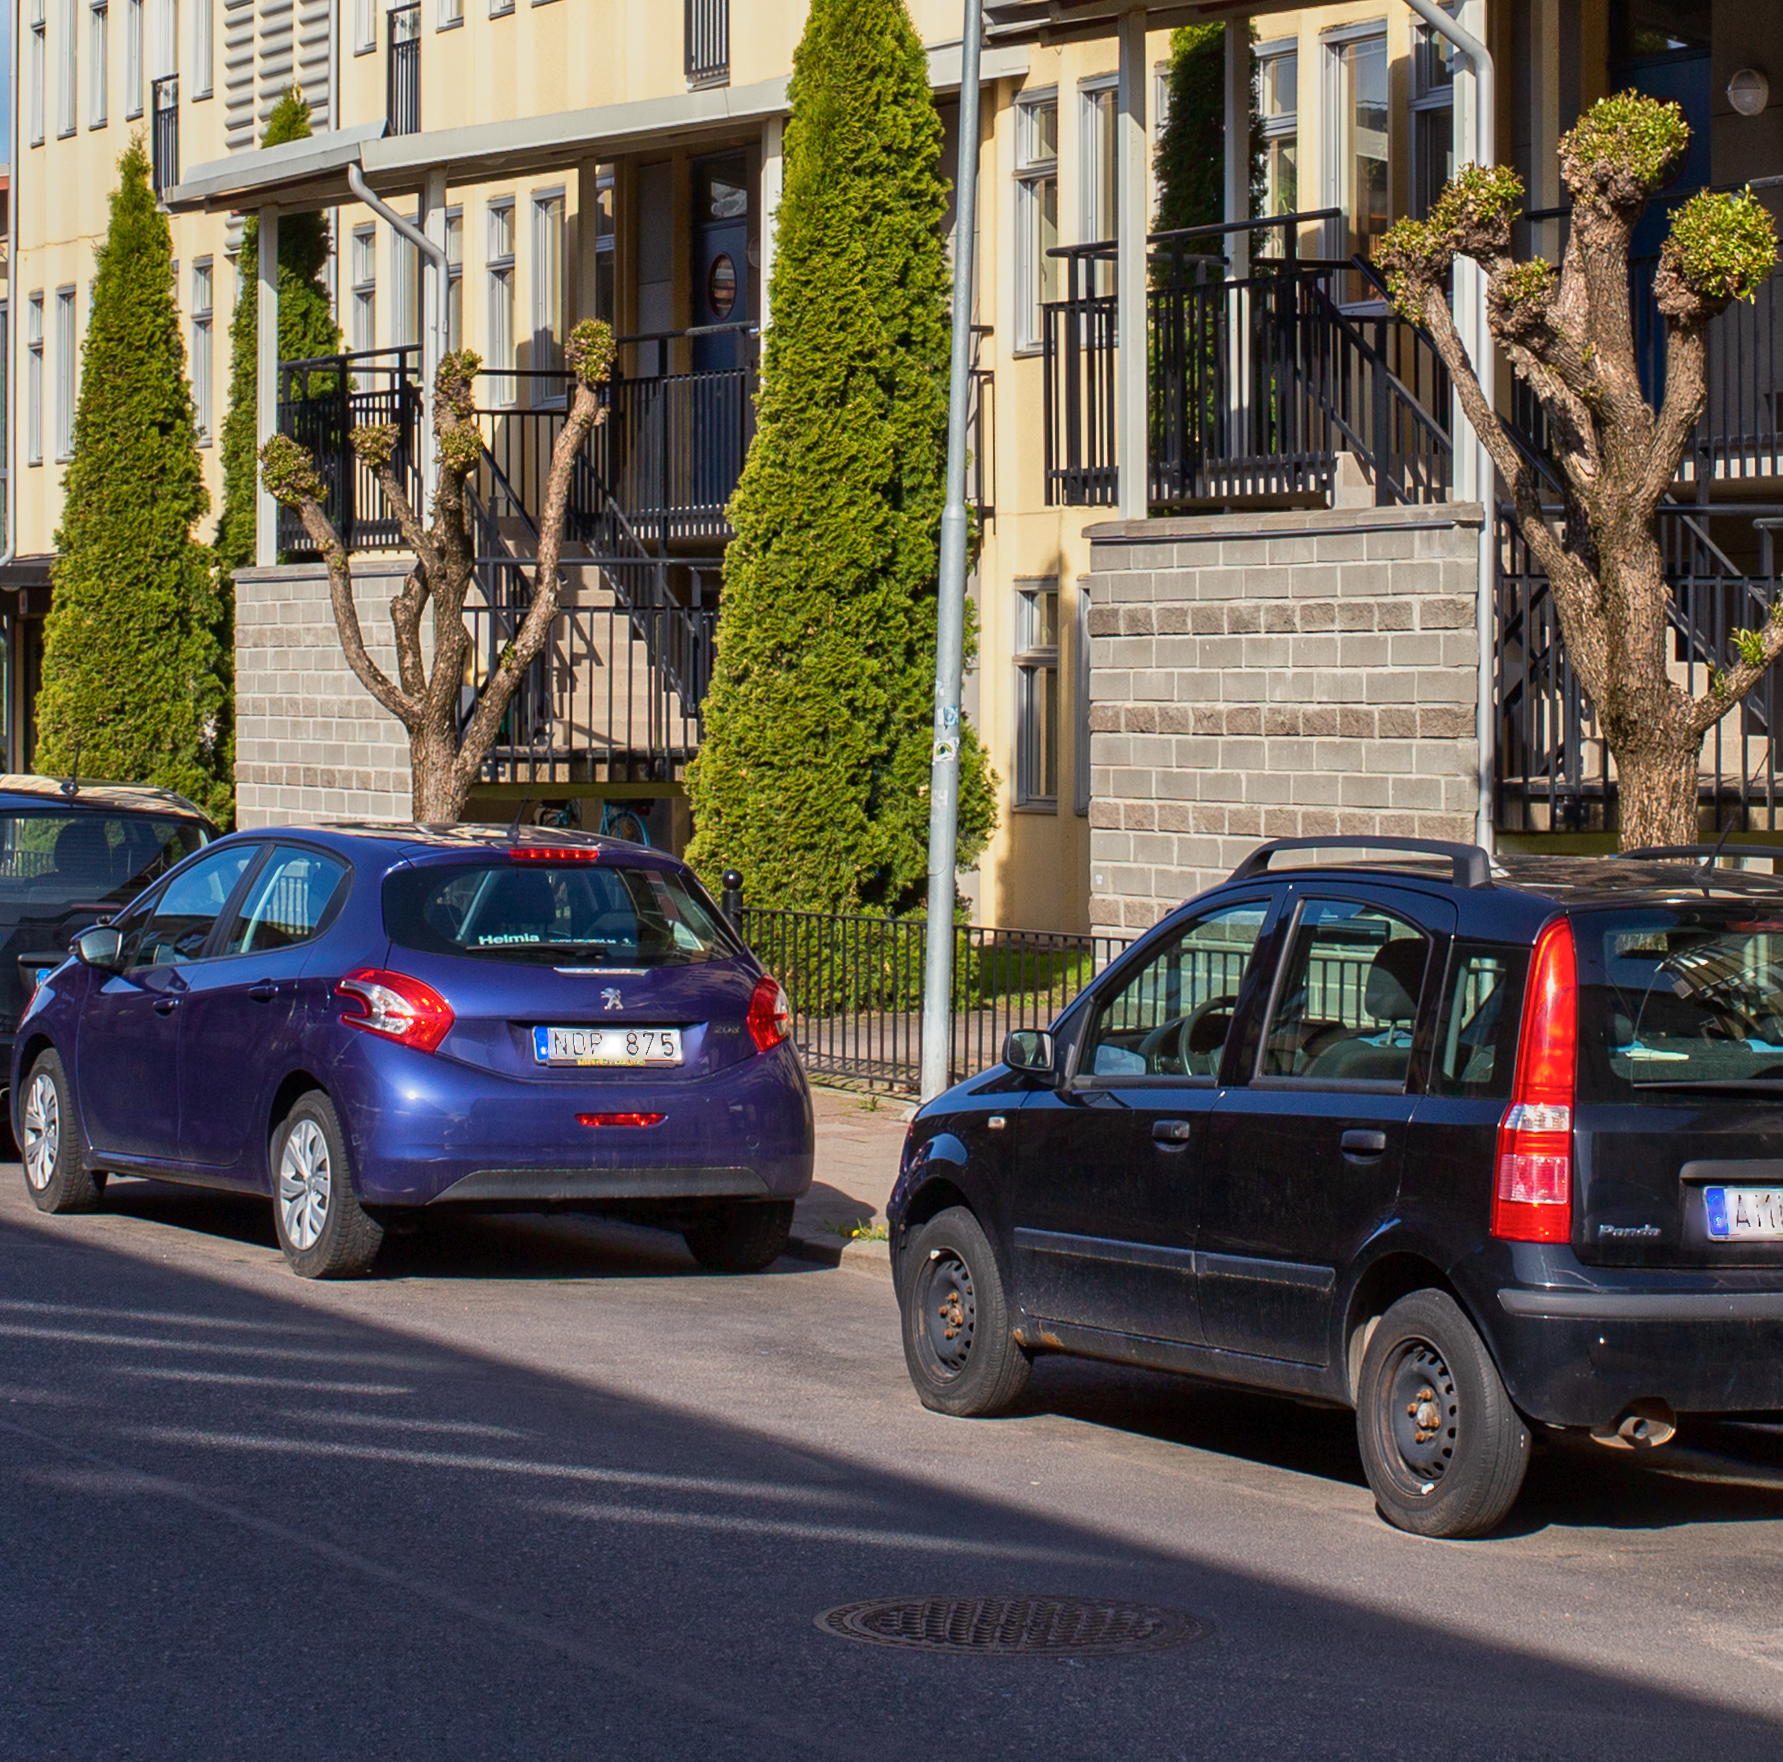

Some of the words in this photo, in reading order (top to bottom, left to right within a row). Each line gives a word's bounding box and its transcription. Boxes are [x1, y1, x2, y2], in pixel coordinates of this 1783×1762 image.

[478, 933, 541, 946] Helmia
[626, 1031, 676, 1057] 875
[1598, 1223, 1662, 1237] Panda
